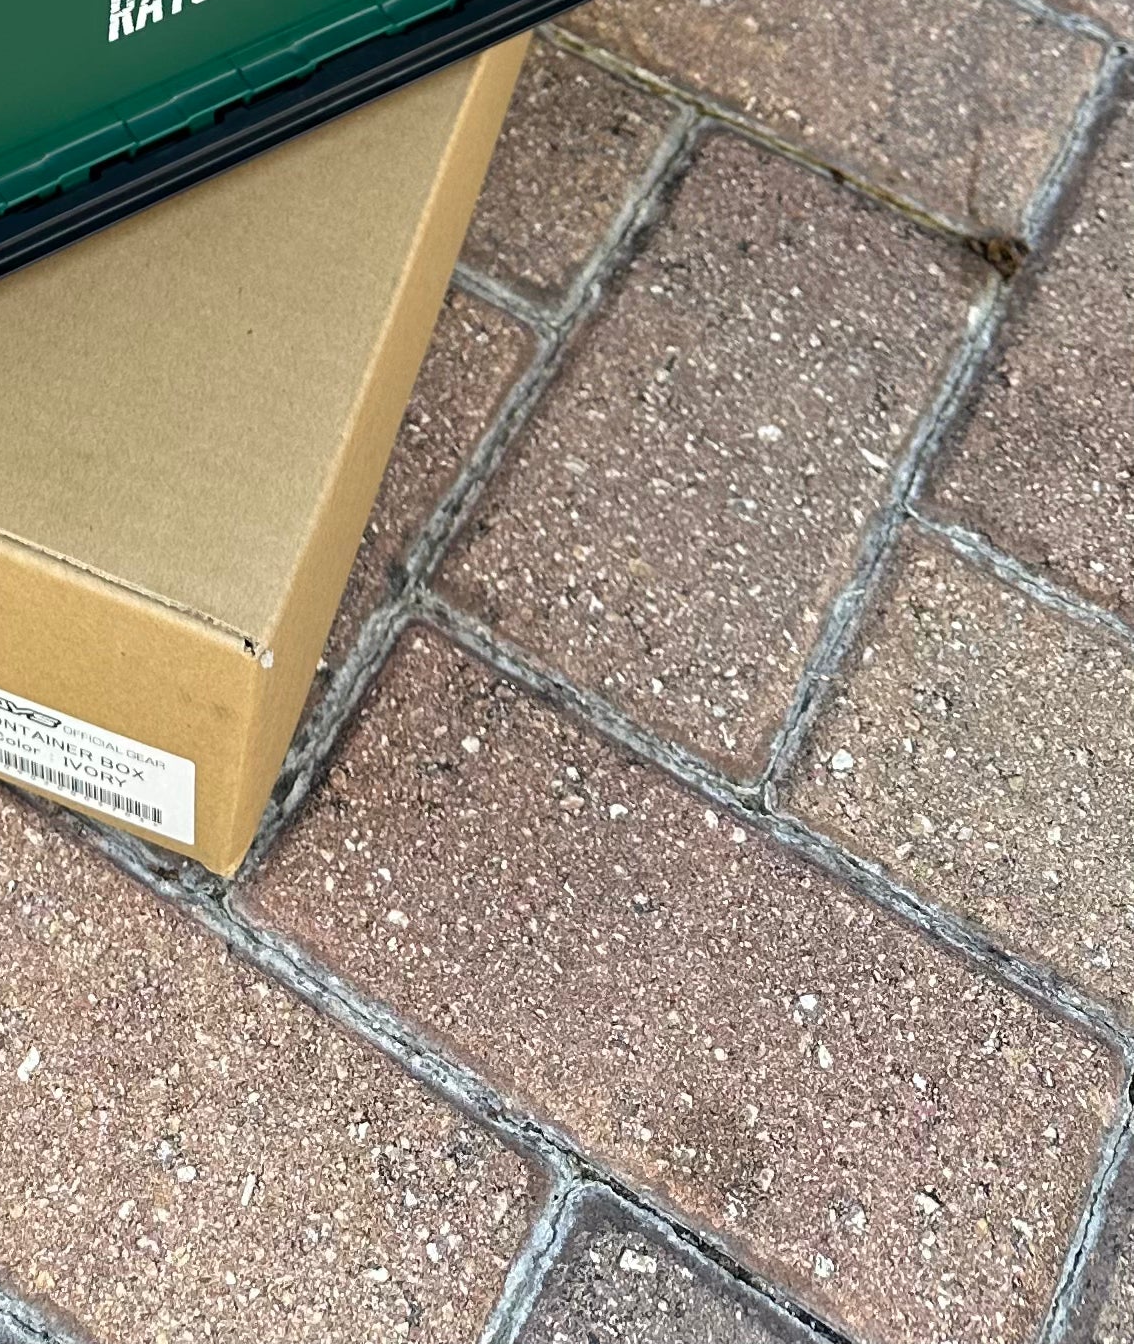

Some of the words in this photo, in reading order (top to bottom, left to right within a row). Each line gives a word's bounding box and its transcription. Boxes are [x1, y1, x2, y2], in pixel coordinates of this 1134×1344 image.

[63, 725, 124, 755] OFFICIAL
[125, 750, 167, 771] GEAR
[63, 756, 128, 788] IVORY
[101, 755, 145, 781] BOX
